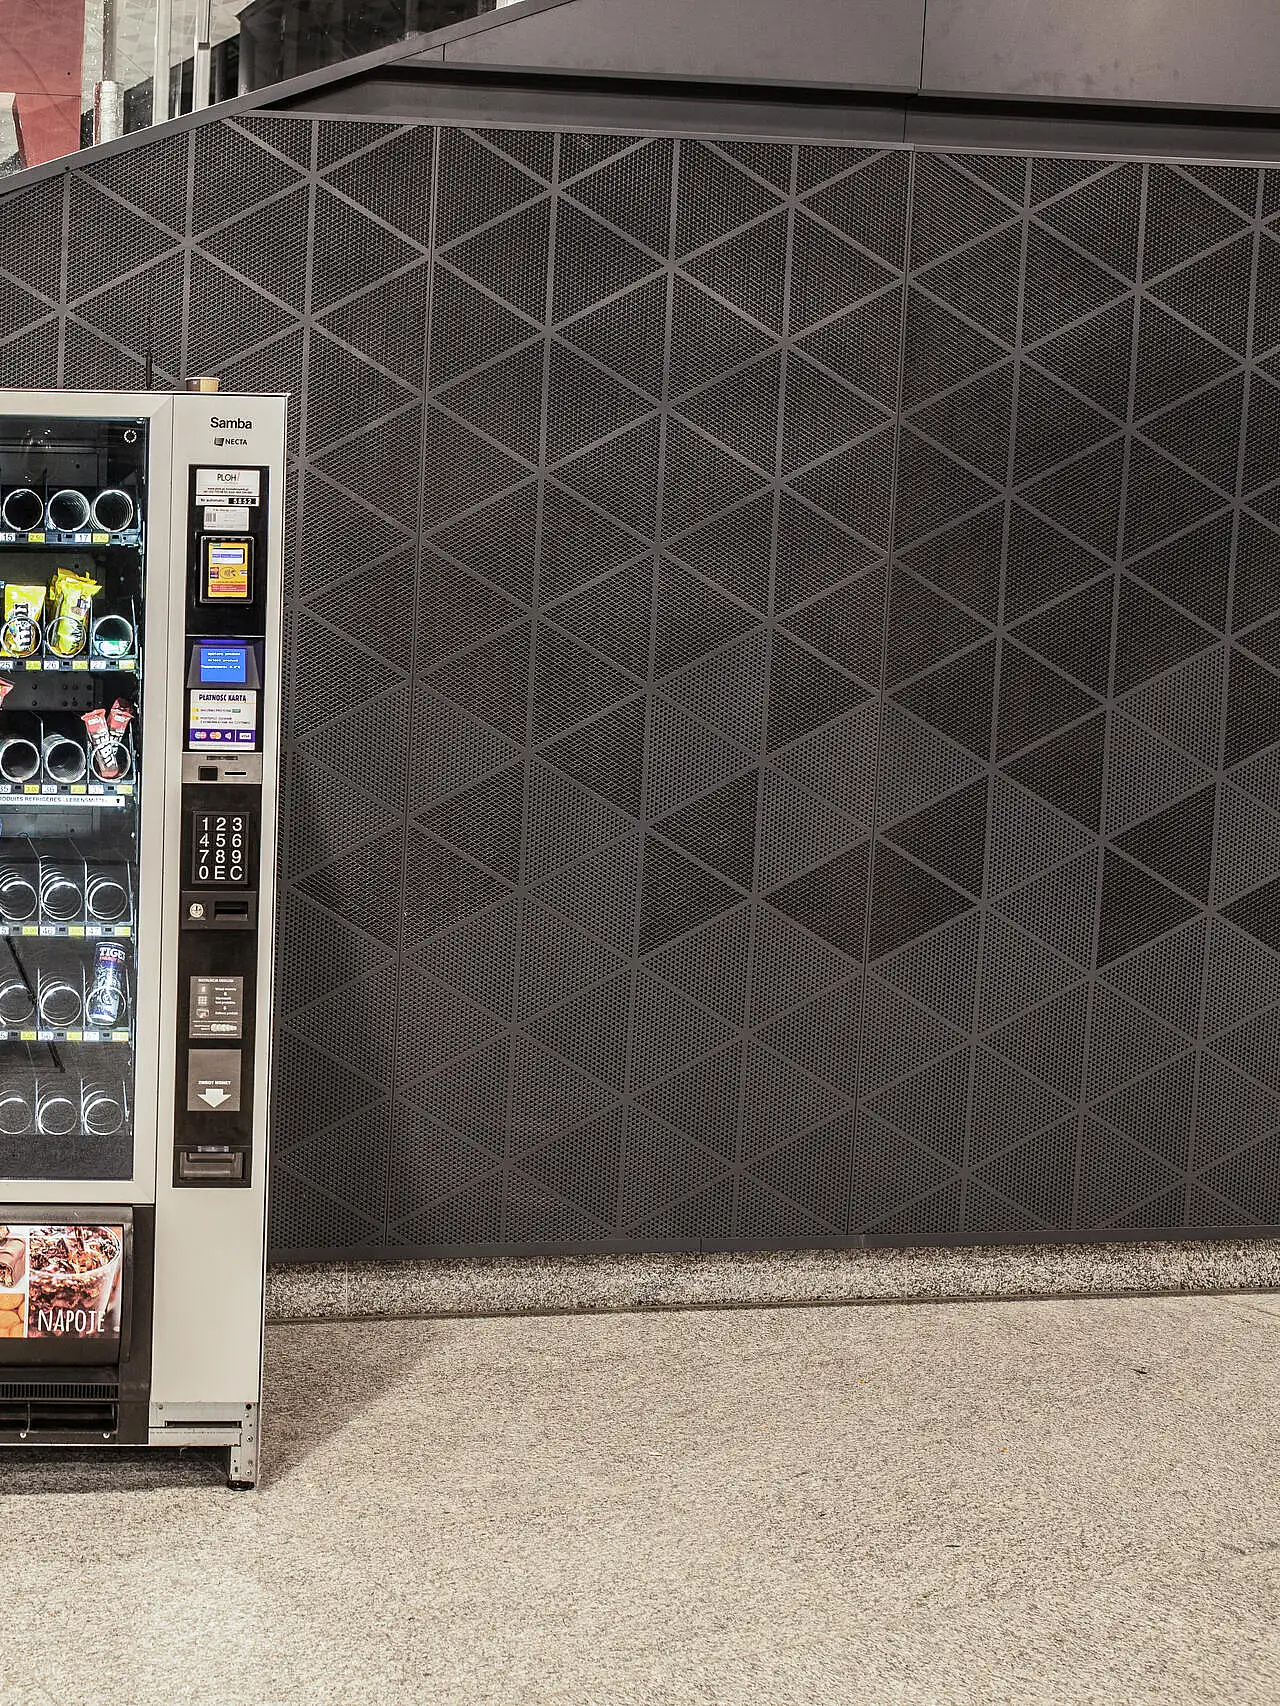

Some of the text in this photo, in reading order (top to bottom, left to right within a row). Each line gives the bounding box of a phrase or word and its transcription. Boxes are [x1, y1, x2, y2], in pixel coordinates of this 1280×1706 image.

[210, 417, 252, 430] Samba
[202, 817, 243, 831] 1 2 3
[199, 833, 242, 848] 4 5 6
[199, 849, 242, 864] 7 8 9
[199, 865, 243, 880] 0 E C
[36, 1308, 106, 1334] NAPOJE
